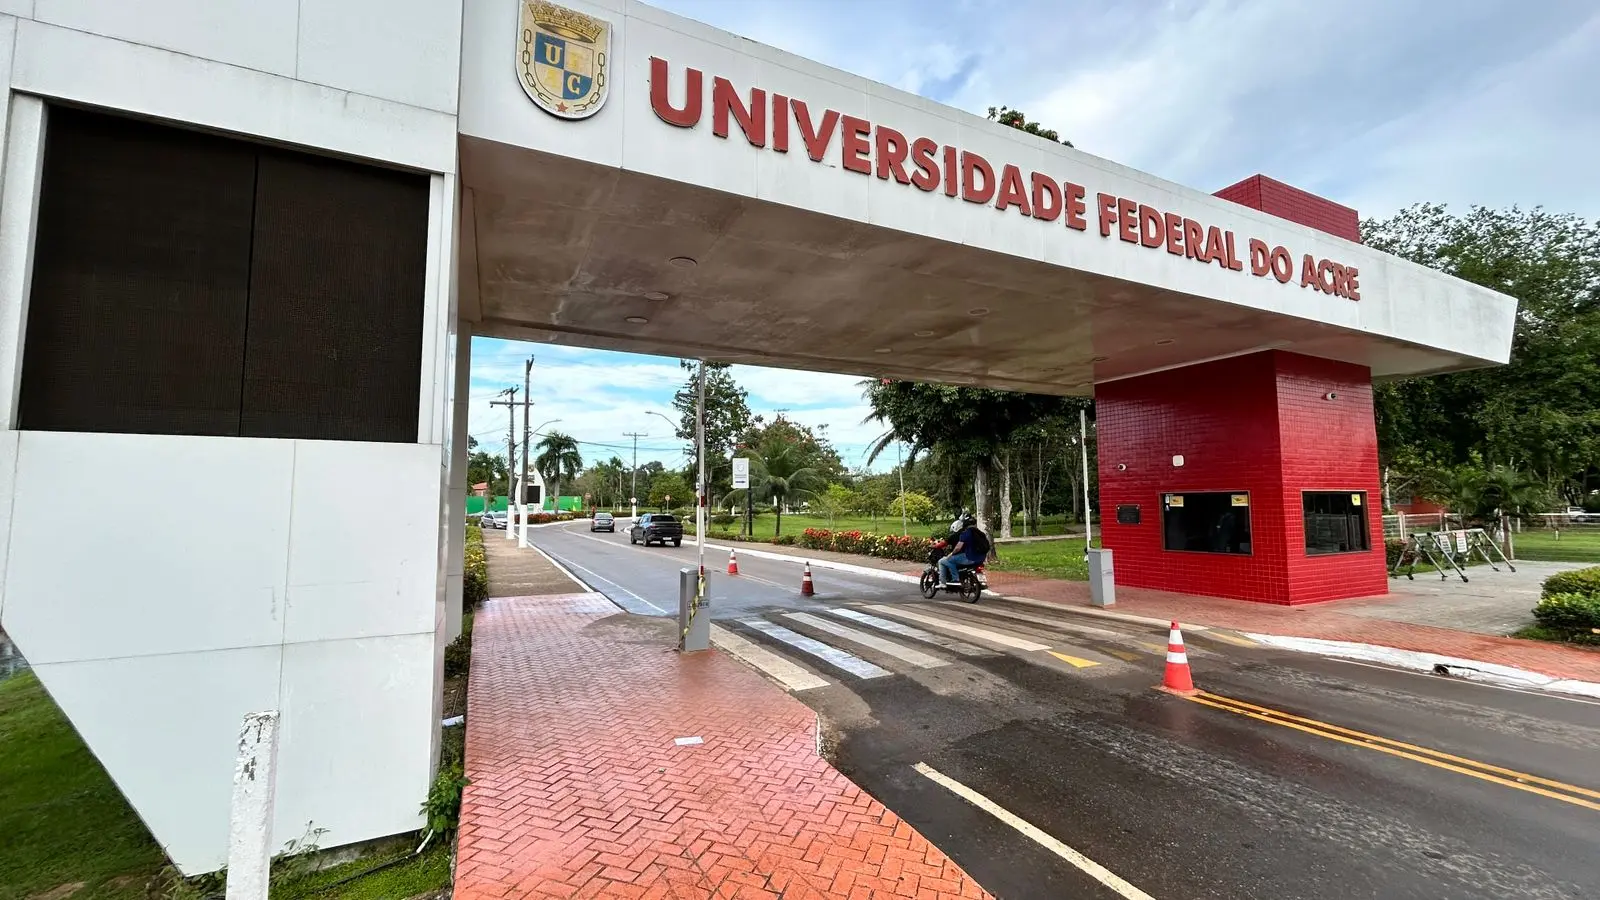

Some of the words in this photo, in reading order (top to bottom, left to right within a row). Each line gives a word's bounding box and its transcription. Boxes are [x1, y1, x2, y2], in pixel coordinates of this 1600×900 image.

[650, 56, 1087, 231] UNIVERSIDADE
[1098, 192, 1244, 271] FEDERAL
[1250, 238, 1293, 283] DO
[1301, 253, 1361, 301] ACRE
